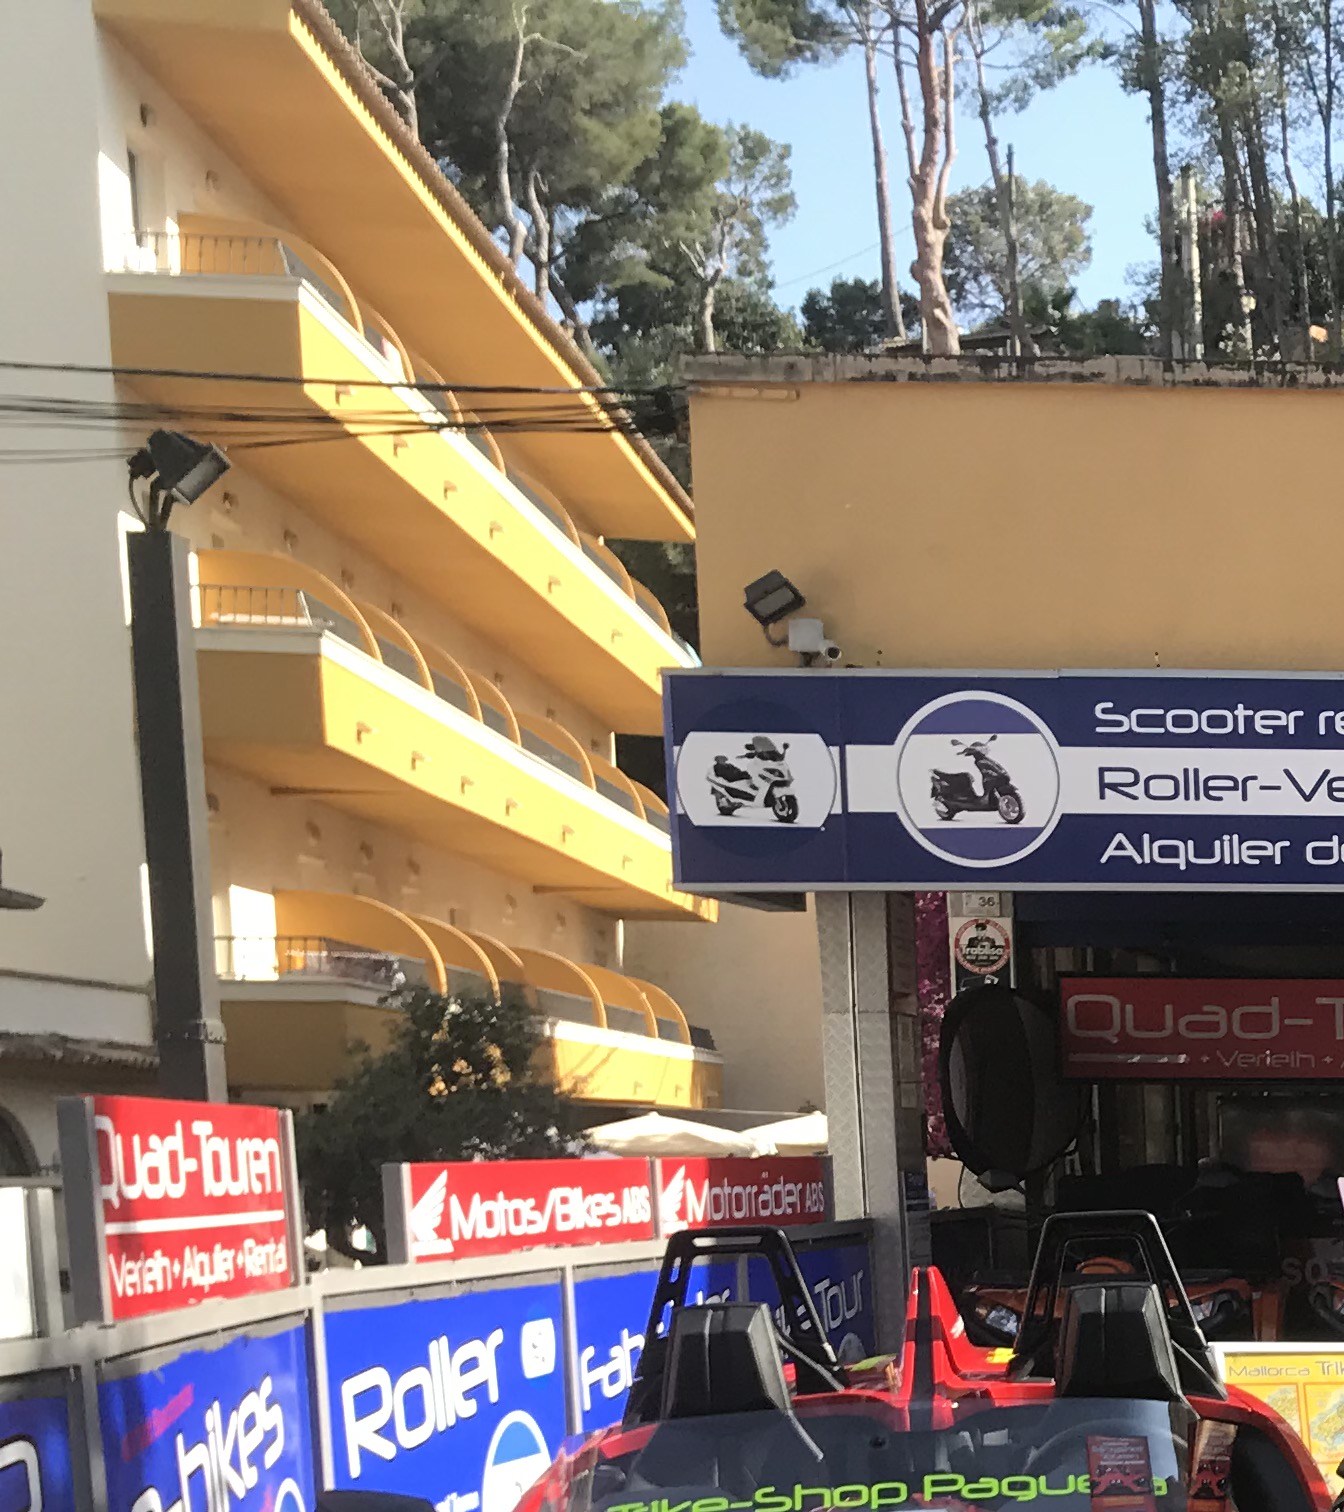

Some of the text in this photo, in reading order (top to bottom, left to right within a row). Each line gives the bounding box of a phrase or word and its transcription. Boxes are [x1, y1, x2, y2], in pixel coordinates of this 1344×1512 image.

[1095, 701, 1305, 736] Scooter
[1099, 831, 1291, 872] Alquiler
[1216, 1049, 1317, 1070] Verleih
[450, 1185, 622, 1241] Motos/Bikes
[621, 1185, 651, 1225] ABS
[686, 1171, 825, 1224] Motorräder ABS
[813, 1269, 865, 1332] Tour
[1228, 1364, 1311, 1378] Mallorca
[339, 1326, 505, 1480] Roller
